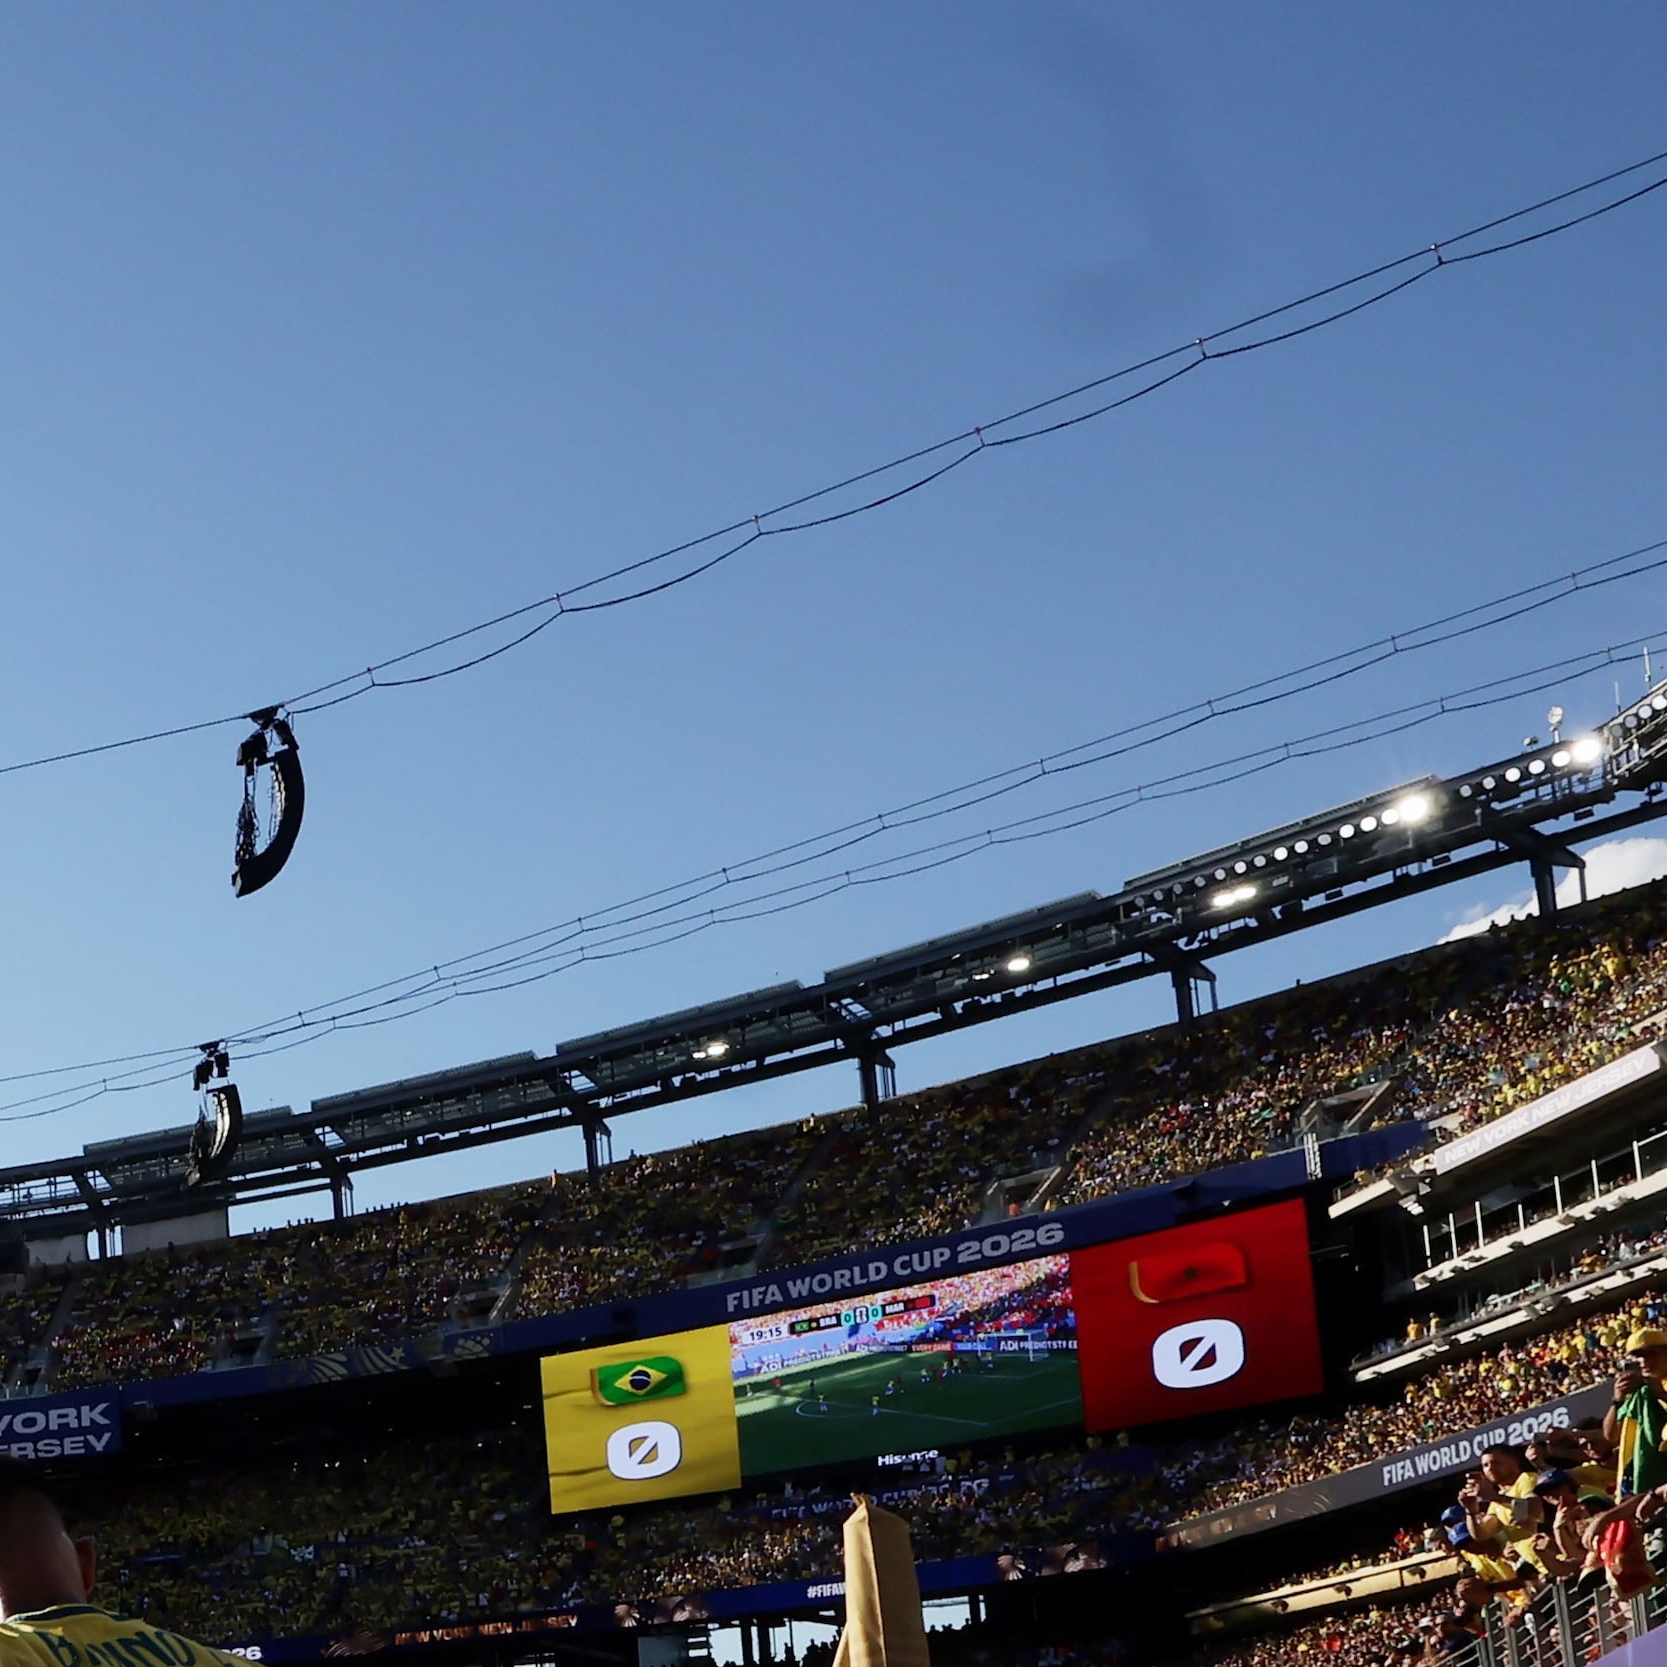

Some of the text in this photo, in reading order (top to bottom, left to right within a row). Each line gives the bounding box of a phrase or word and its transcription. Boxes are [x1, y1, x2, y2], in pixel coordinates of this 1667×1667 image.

[726, 1222, 1066, 1313] FIFA WORLD CUP 2026
[749, 1327, 783, 1341] 19:15
[1152, 1318, 1246, 1389] 0
[606, 1420, 682, 1480] 0
[1382, 1407, 1570, 1487] FIFA WORLD CUP 2026
[395, 1630, 431, 1645] NW
[478, 1621, 514, 1636] NEW
[517, 1614, 579, 1633] JESEY
